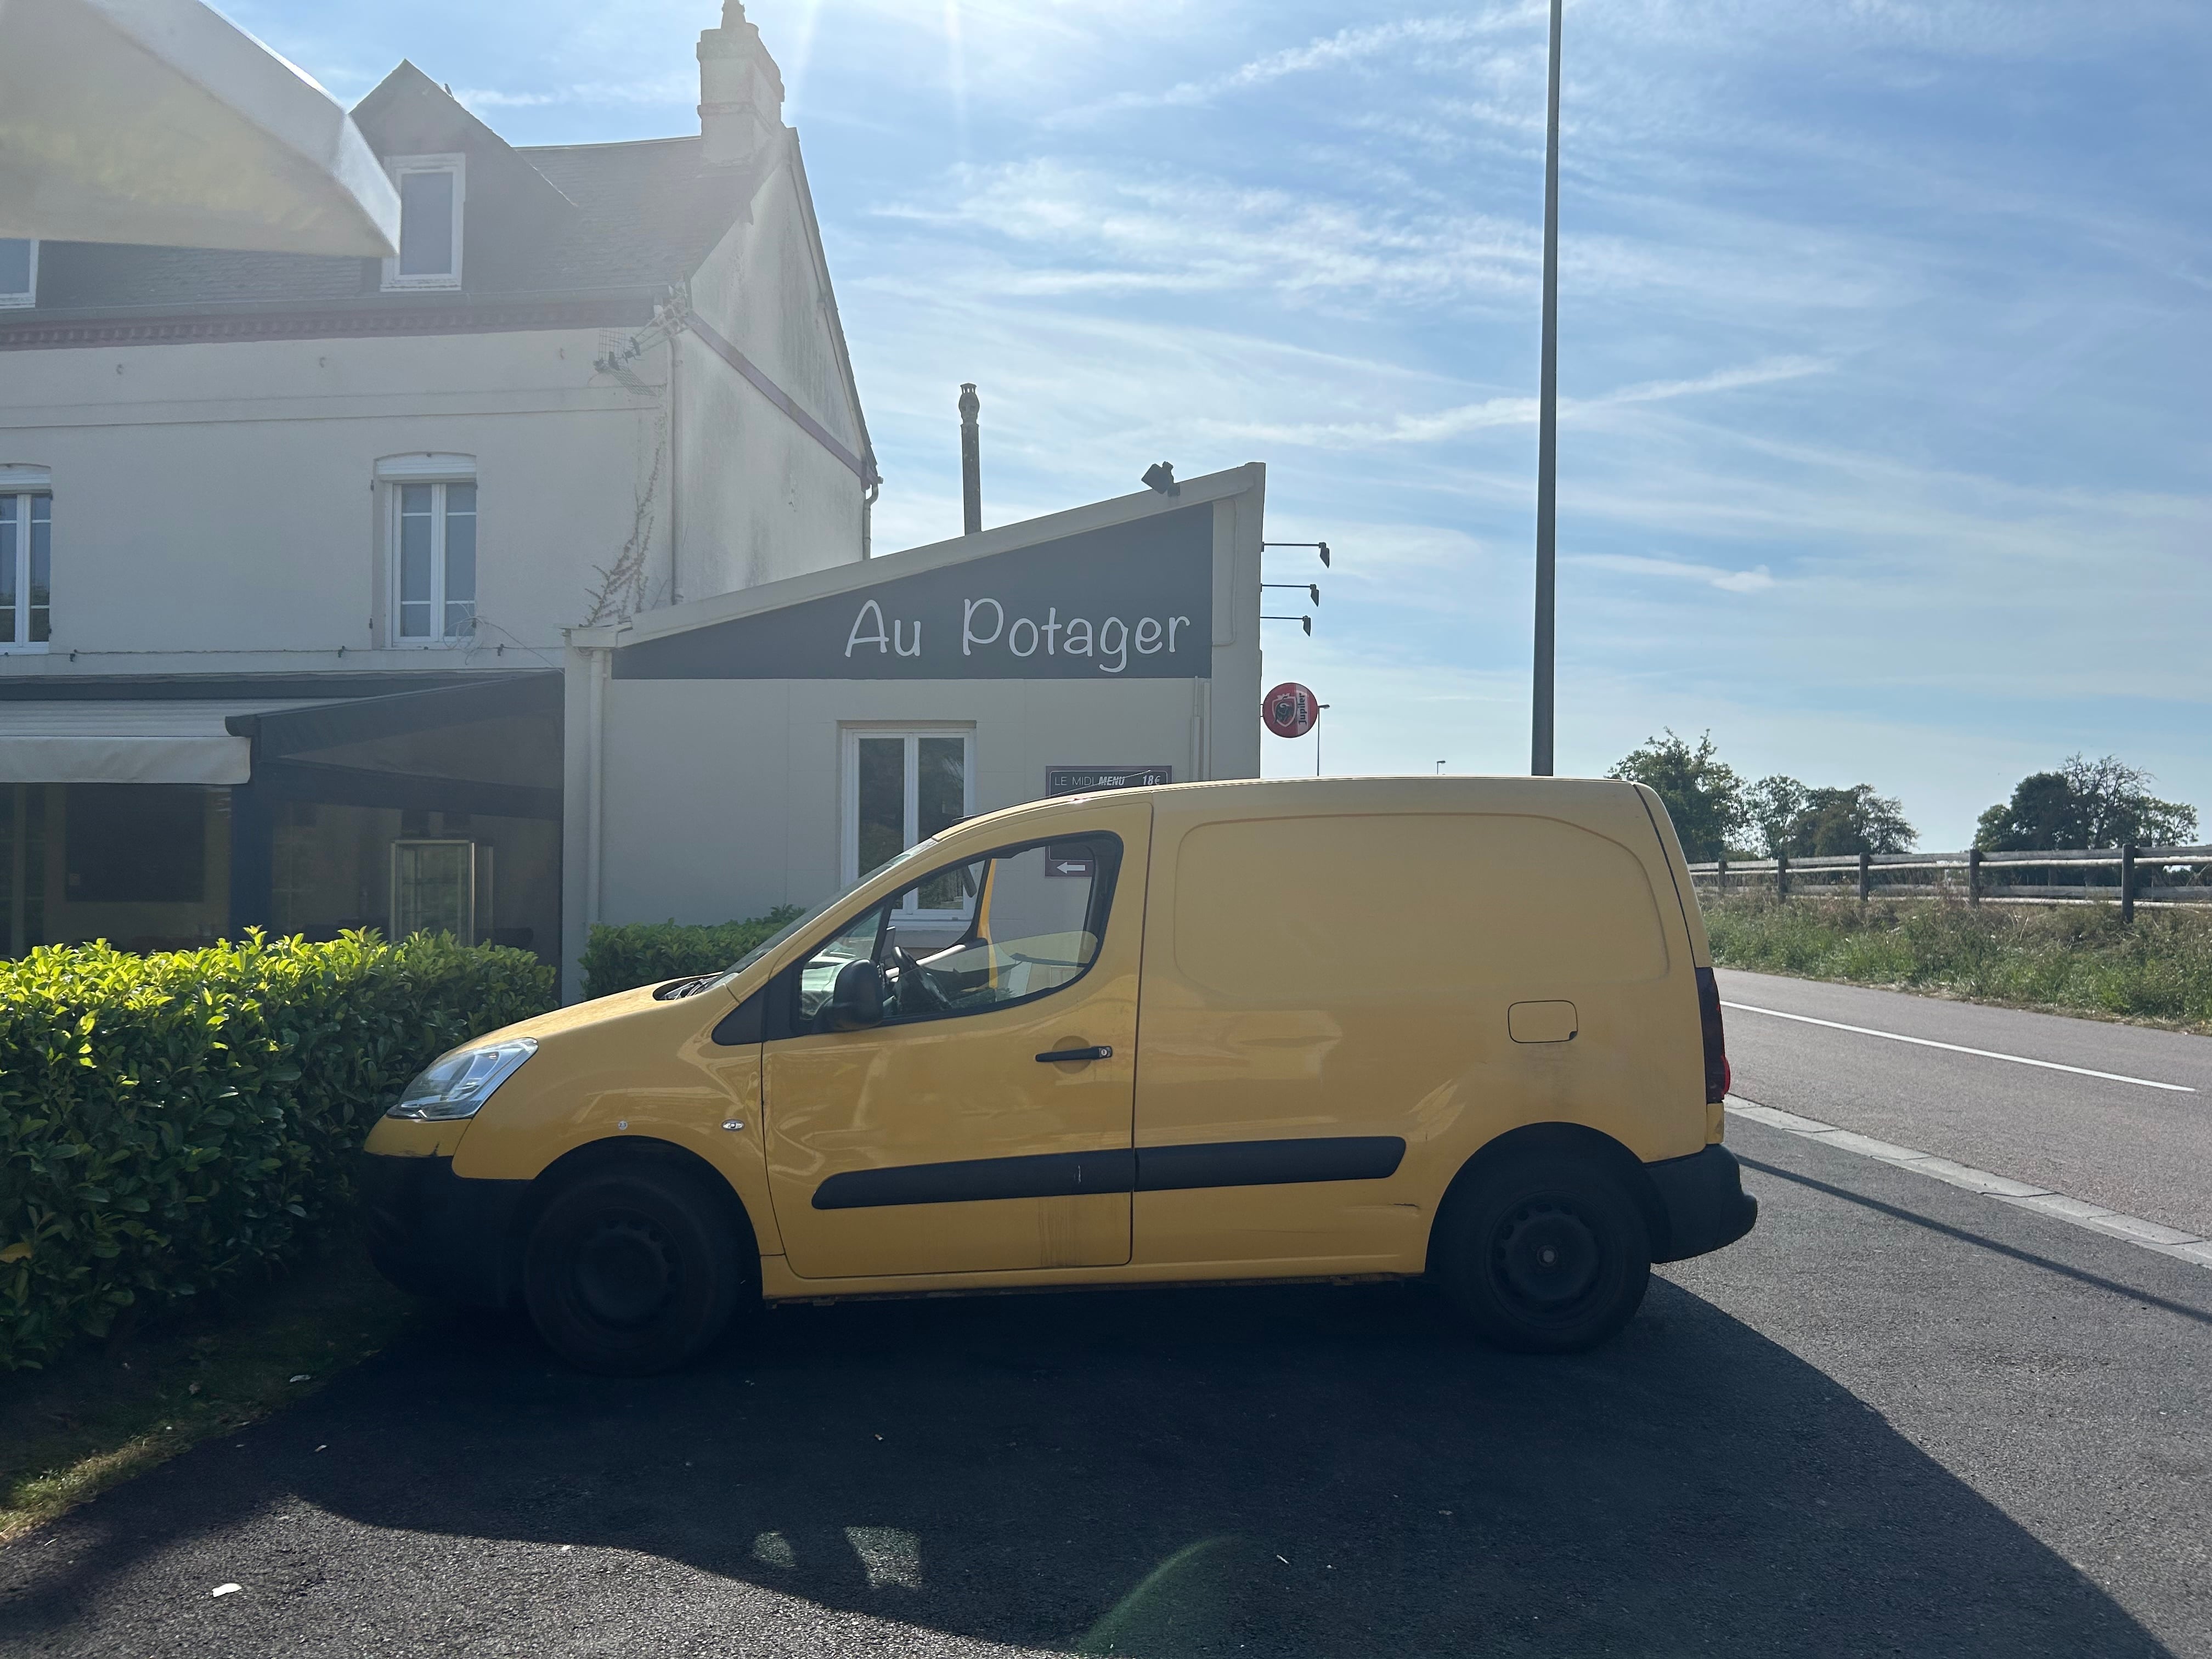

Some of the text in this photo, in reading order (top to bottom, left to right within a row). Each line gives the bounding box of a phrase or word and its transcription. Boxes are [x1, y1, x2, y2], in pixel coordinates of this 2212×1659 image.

[845, 598, 1190, 673] Au Potager
[1297, 692, 1307, 726] Jupiler
[1054, 776, 1067, 786] LE
[1072, 776, 1094, 786] MIDI
[1098, 776, 1125, 786] MENU
